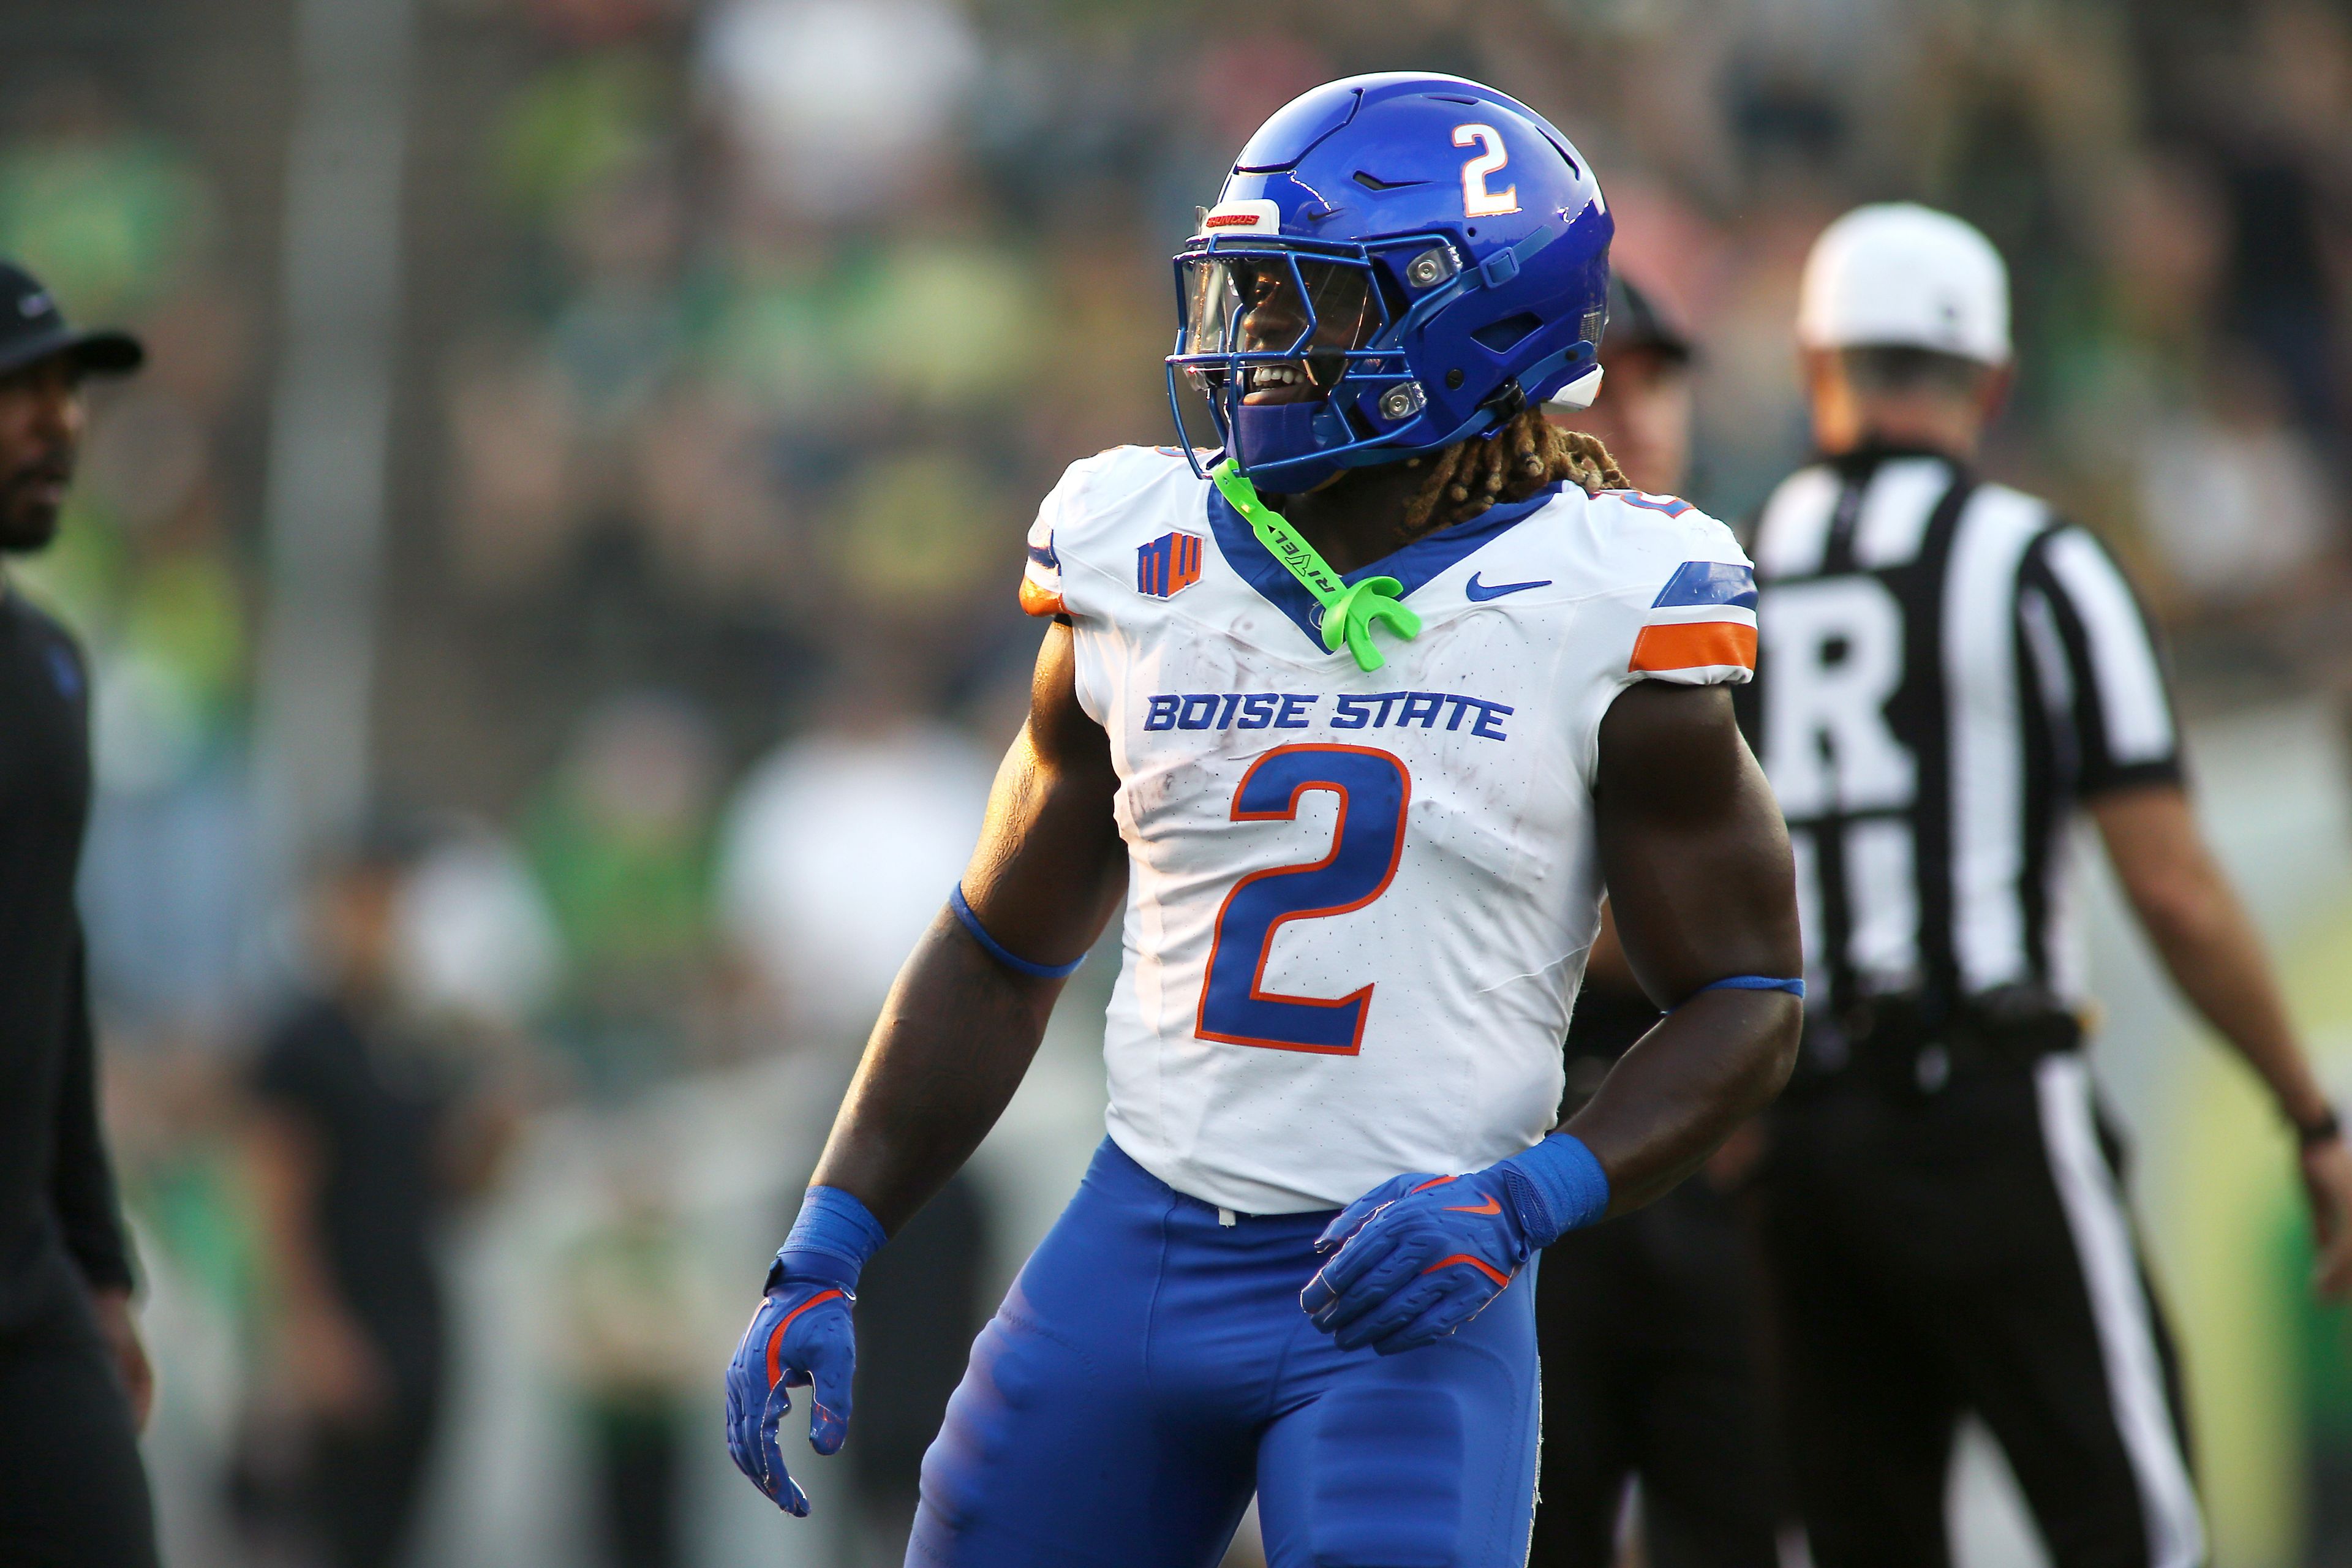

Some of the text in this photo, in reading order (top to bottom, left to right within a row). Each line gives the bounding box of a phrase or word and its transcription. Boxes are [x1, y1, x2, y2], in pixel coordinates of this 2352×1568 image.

[1452, 123, 1518, 217] 2
[1144, 692, 1515, 742] BOISE STATE
[1759, 575, 1917, 812] R
[1194, 743, 1412, 1056] 2
